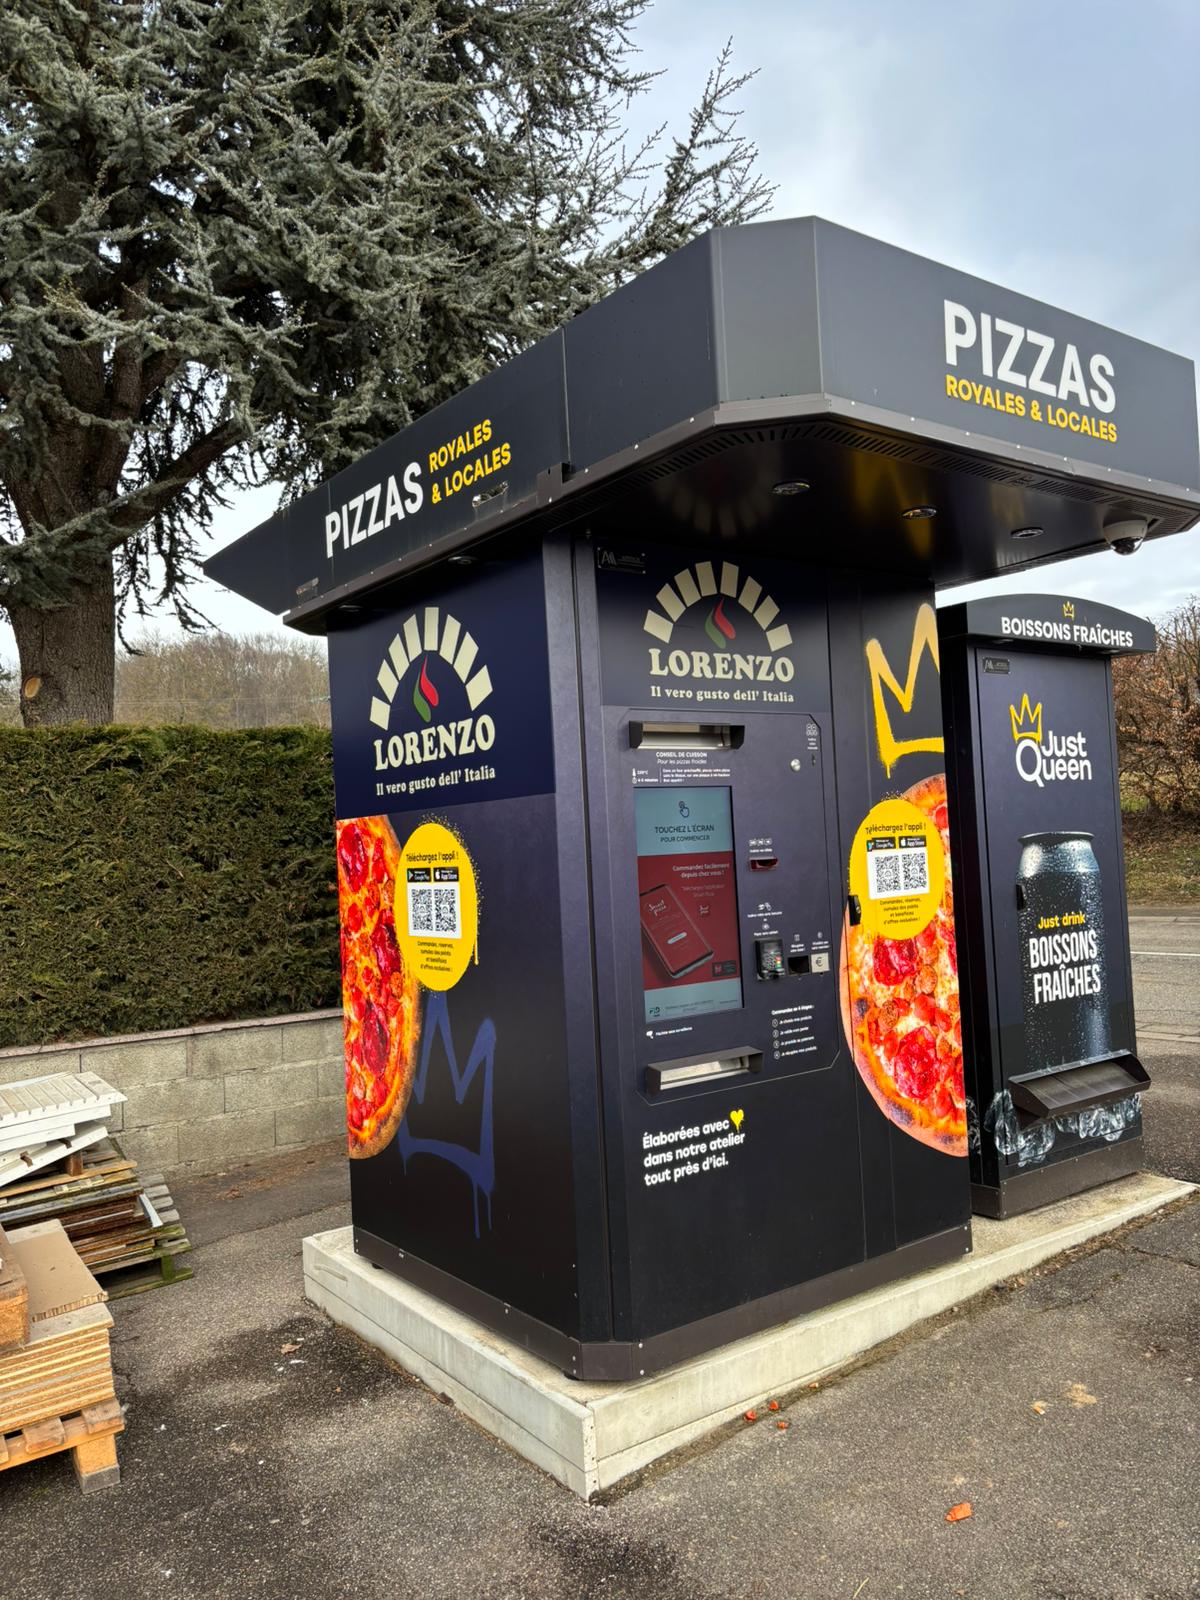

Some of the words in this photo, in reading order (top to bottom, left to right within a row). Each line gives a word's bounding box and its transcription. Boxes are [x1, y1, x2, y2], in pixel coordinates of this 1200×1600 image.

[943, 298, 1117, 415] PIZZAS
[945, 374, 1026, 418] ROYALES
[1030, 400, 1042, 422] &
[1046, 403, 1118, 443] LOCALES
[428, 418, 493, 474] ROYALES
[431, 482, 442, 504] &
[444, 442, 512, 498] LOCALES
[324, 461, 425, 559] PIZZAS
[1001, 616, 1071, 641] BOISSONS
[1073, 623, 1134, 648] FRAÎCHES
[648, 648, 795, 683] LORENZO
[650, 685, 661, 697] Il
[665, 688, 693, 699] vero
[696, 688, 731, 702] gusto
[762, 690, 795, 703] Italia
[373, 713, 496, 771] LORENZO
[1041, 730, 1087, 758] Just
[376, 783, 384, 796] Il
[386, 781, 407, 795] vero
[408, 775, 436, 795] gusto
[464, 764, 496, 783] Italia
[1016, 738, 1093, 788] Queen
[654, 825, 686, 834] TOUCHEZ
[865, 823, 903, 835] Téléchargez
[875, 841, 887, 849] Google
[672, 863, 704, 871] Commandez
[1038, 914, 1060, 930] Just
[1062, 910, 1086, 927] drink
[1029, 929, 1098, 969] BOISSONS
[1033, 963, 1101, 1005] FRAÎCHES
[642, 1126, 701, 1149] Élaborées
[702, 1119, 730, 1135] avec
[643, 1152, 673, 1168] dans
[675, 1142, 708, 1160] notre
[709, 1132, 746, 1151] atelier
[644, 1168, 672, 1186] tout
[674, 1160, 700, 1182] près
[702, 1152, 729, 1171] d'ici.
